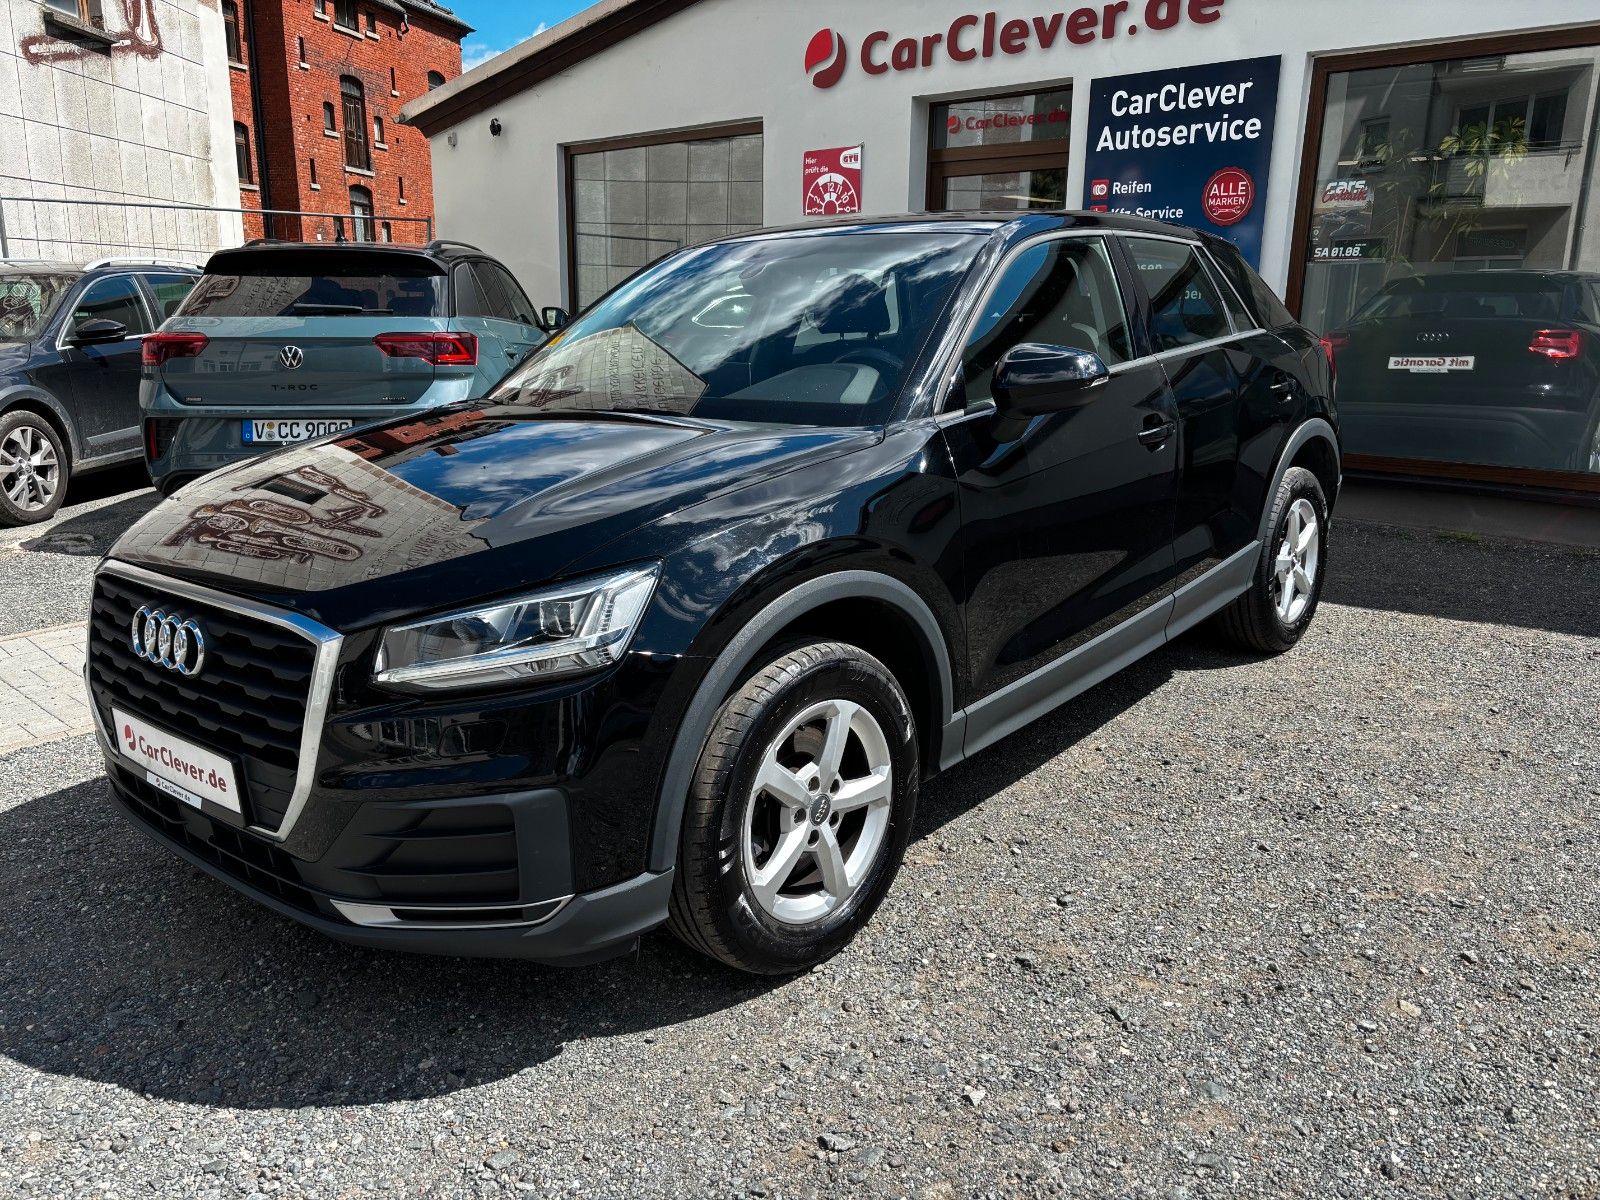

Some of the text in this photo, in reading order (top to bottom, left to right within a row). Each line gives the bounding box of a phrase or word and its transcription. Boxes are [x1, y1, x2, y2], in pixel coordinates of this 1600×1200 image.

[860, 0, 1224, 75] CarClever.de
[1111, 82, 1254, 117] CarClever
[1096, 114, 1262, 152] Autoservice
[805, 157, 817, 165] Hier
[820, 165, 829, 173] die
[1112, 181, 1152, 195] Reifen
[1210, 182, 1247, 196] ALLE
[1208, 197, 1246, 206] MARKEN
[1313, 247, 1329, 257] SA
[254, 422, 265, 439] V
[278, 422, 301, 438] CC
[139, 736, 227, 792] CarClever.de
